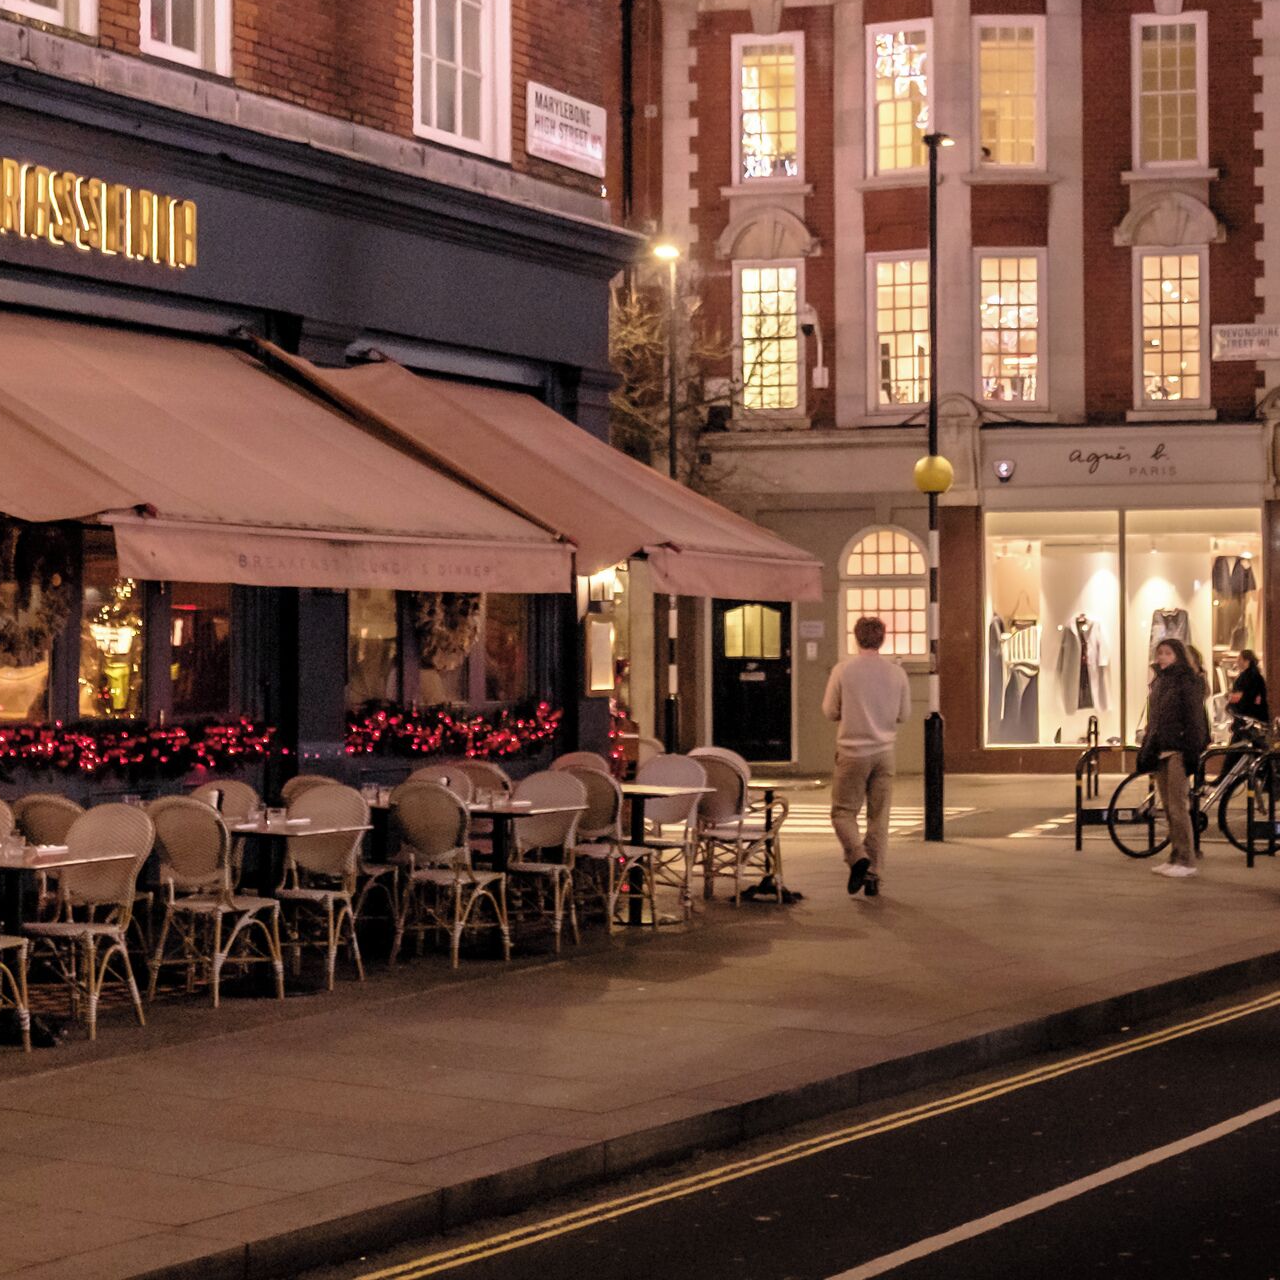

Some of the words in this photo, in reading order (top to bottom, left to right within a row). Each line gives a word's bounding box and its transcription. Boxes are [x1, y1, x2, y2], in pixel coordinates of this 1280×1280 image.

[534, 90, 592, 128] MARYLEBONE
[534, 112, 557, 137] HIGH
[558, 121, 589, 148] STREET
[1219, 327, 1280, 338] DEVONSHIRE
[1128, 466, 1177, 477] PARIS
